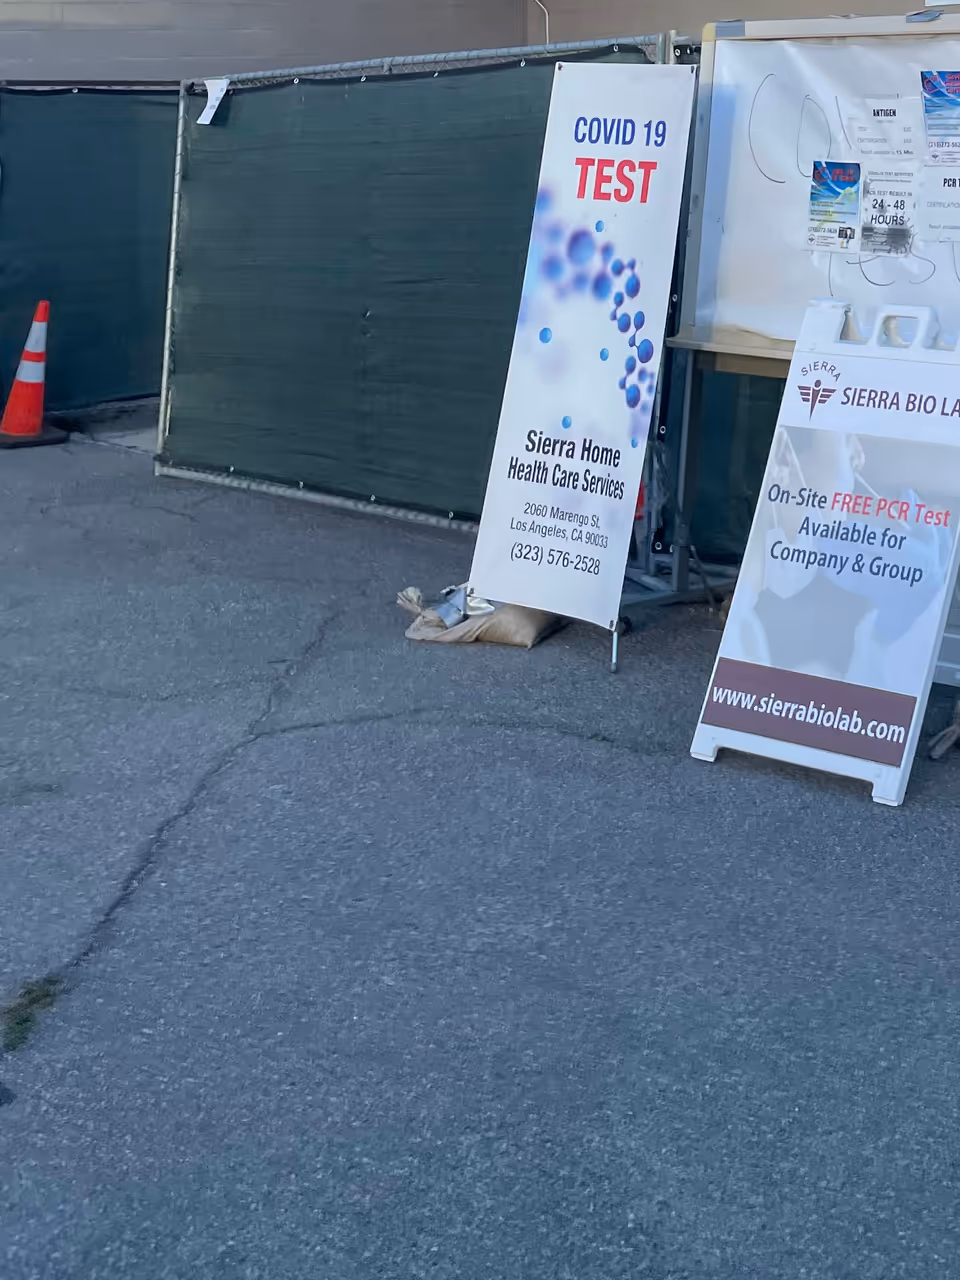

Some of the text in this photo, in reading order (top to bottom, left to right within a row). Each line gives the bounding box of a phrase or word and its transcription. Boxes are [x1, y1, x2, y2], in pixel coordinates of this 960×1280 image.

[872, 108, 897, 118] ANTIGEN
[574, 116, 667, 147] COVID 19
[574, 157, 658, 203] TEST
[943, 177, 957, 187] PCR
[870, 214, 905, 226] HOURS
[872, 198, 884, 209] 24
[893, 199, 905, 210] 48
[801, 360, 842, 382] SIERRA
[841, 386, 900, 411] SIERRA
[905, 393, 938, 414] BIO
[525, 429, 621, 468] Sierra Home
[507, 456, 625, 500] Health Care Services
[524, 502, 547, 518] 2060
[550, 506, 589, 527] Marengo
[768, 483, 952, 527] On-Site FREE PCR Test
[510, 517, 609, 549] Los Angeles, CA 90033
[798, 516, 907, 550] Available for
[510, 541, 601, 576] (323) 576-2528
[770, 540, 923, 587] Company & Group
[712, 686, 906, 745] www.sierrabiolab.com
